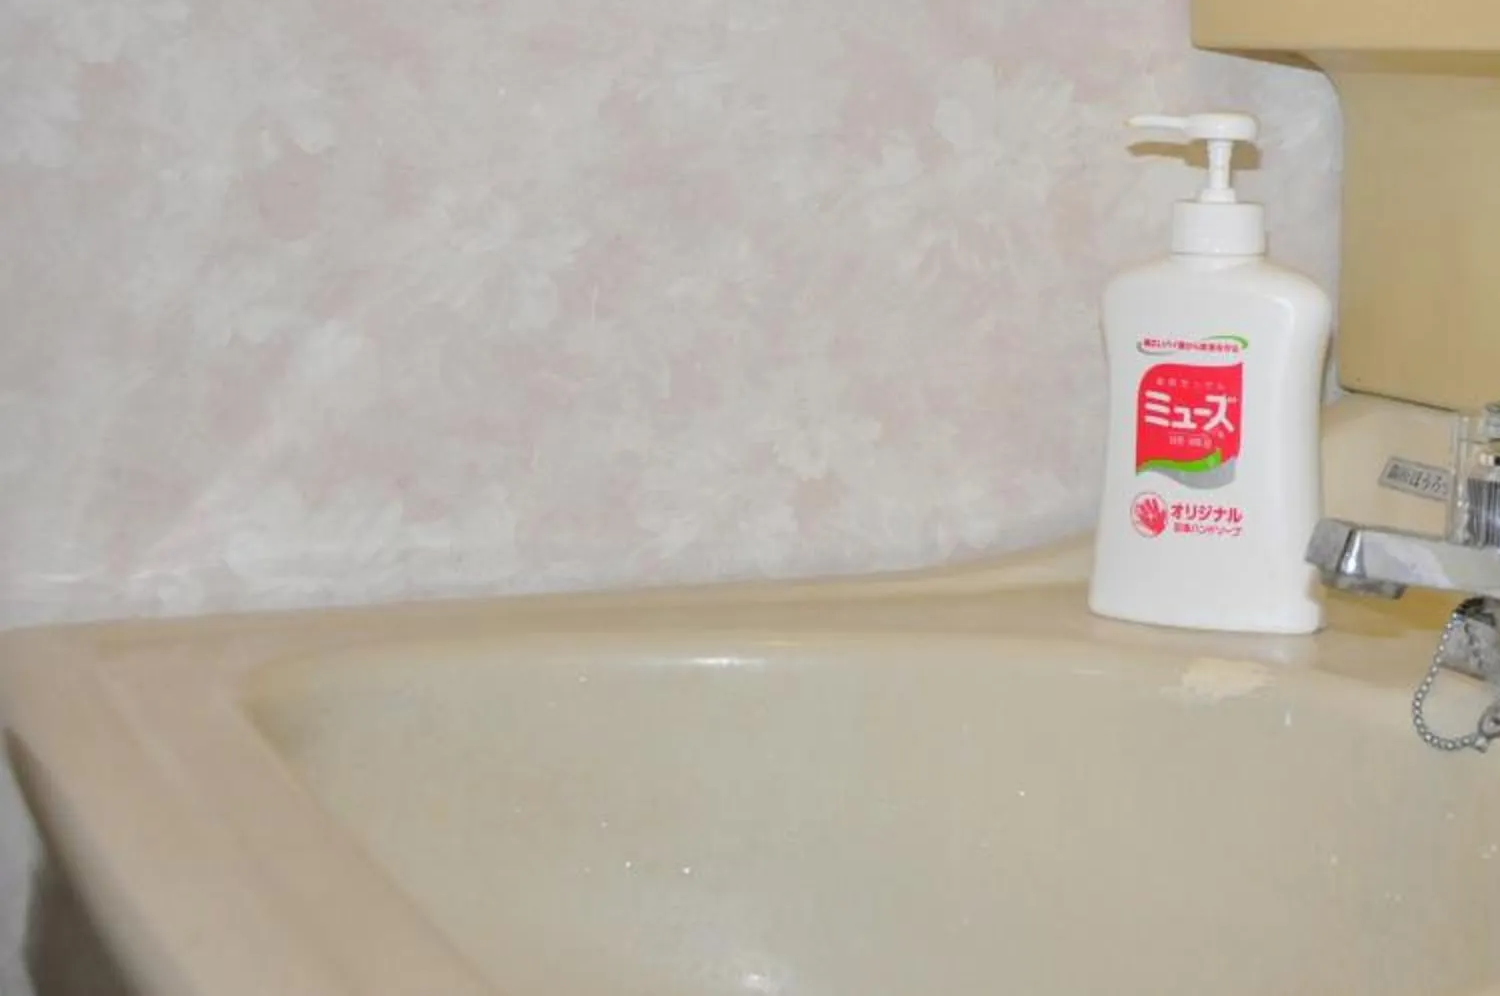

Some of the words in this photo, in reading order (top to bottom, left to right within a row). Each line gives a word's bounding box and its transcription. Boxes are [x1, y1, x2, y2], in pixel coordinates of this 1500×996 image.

[1144, 389, 1238, 433] ミューズ
[1170, 503, 1244, 523] オリジナル
